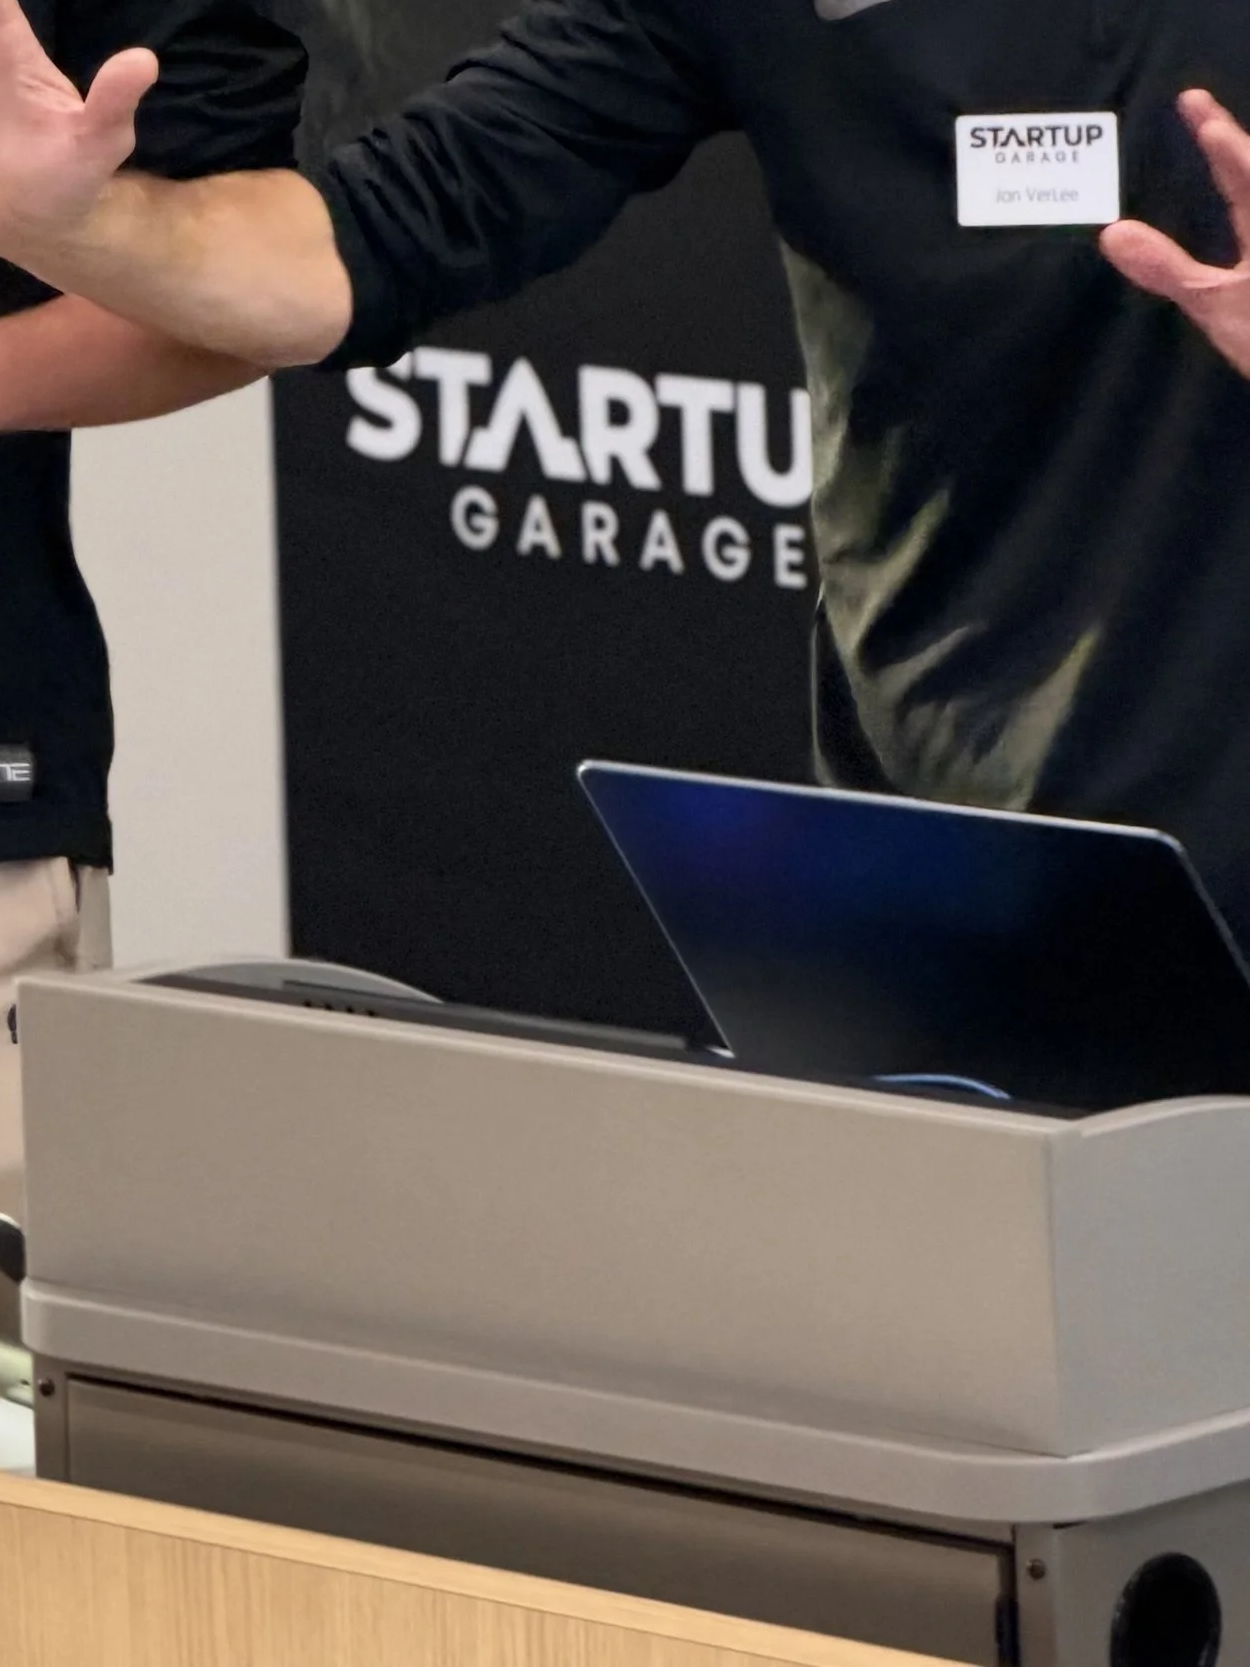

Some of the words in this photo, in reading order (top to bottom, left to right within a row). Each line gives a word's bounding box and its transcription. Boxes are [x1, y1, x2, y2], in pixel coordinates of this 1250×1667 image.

[969, 124, 1103, 149] STARTUP
[994, 150, 1080, 164] GARAGE
[452, 486, 807, 589] GARAGE
